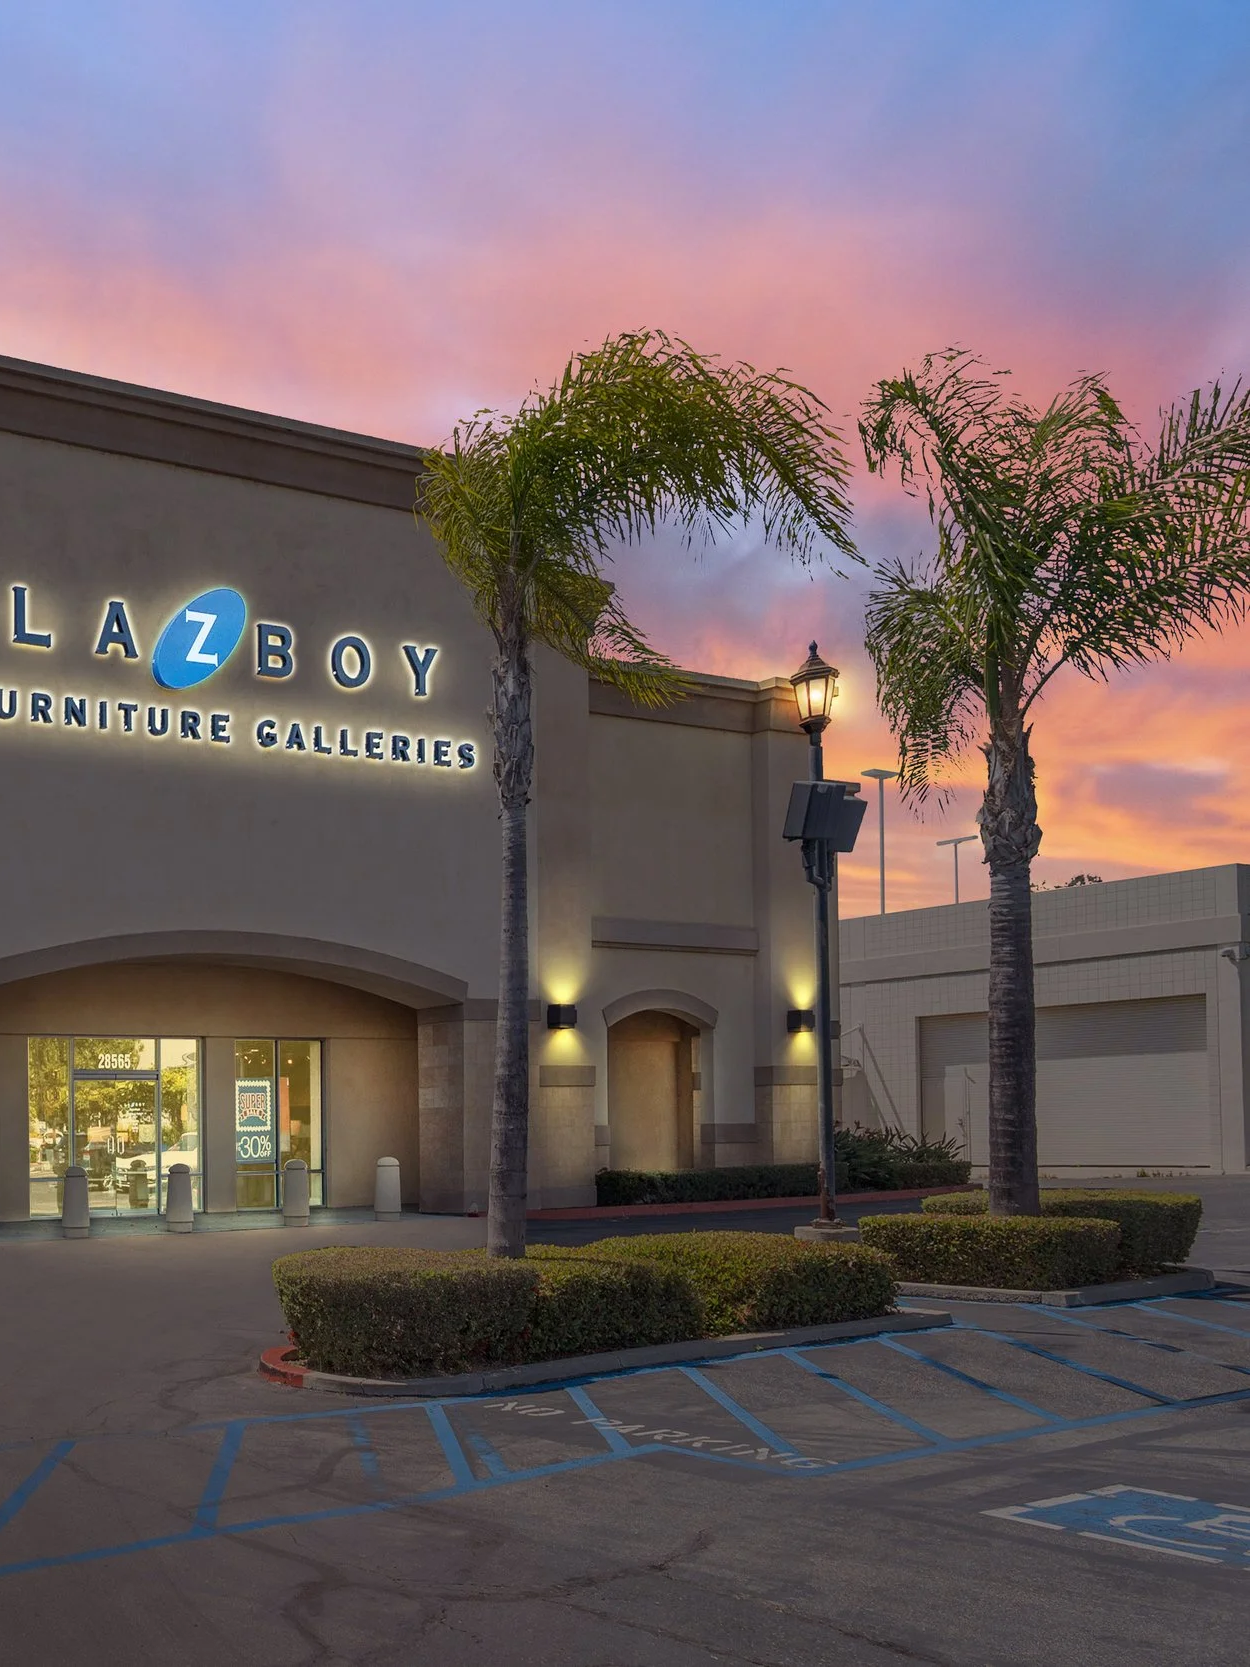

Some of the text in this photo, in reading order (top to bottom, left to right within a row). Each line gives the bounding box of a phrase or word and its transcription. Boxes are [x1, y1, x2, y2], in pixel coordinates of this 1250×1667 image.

[255, 718, 478, 771] GALLERIES
[98, 1053, 131, 1069] 28565
[240, 1093, 266, 1110] SUPER
[240, 1135, 271, 1158] 30%
[484, 1402, 839, 1470] NO PARKING
